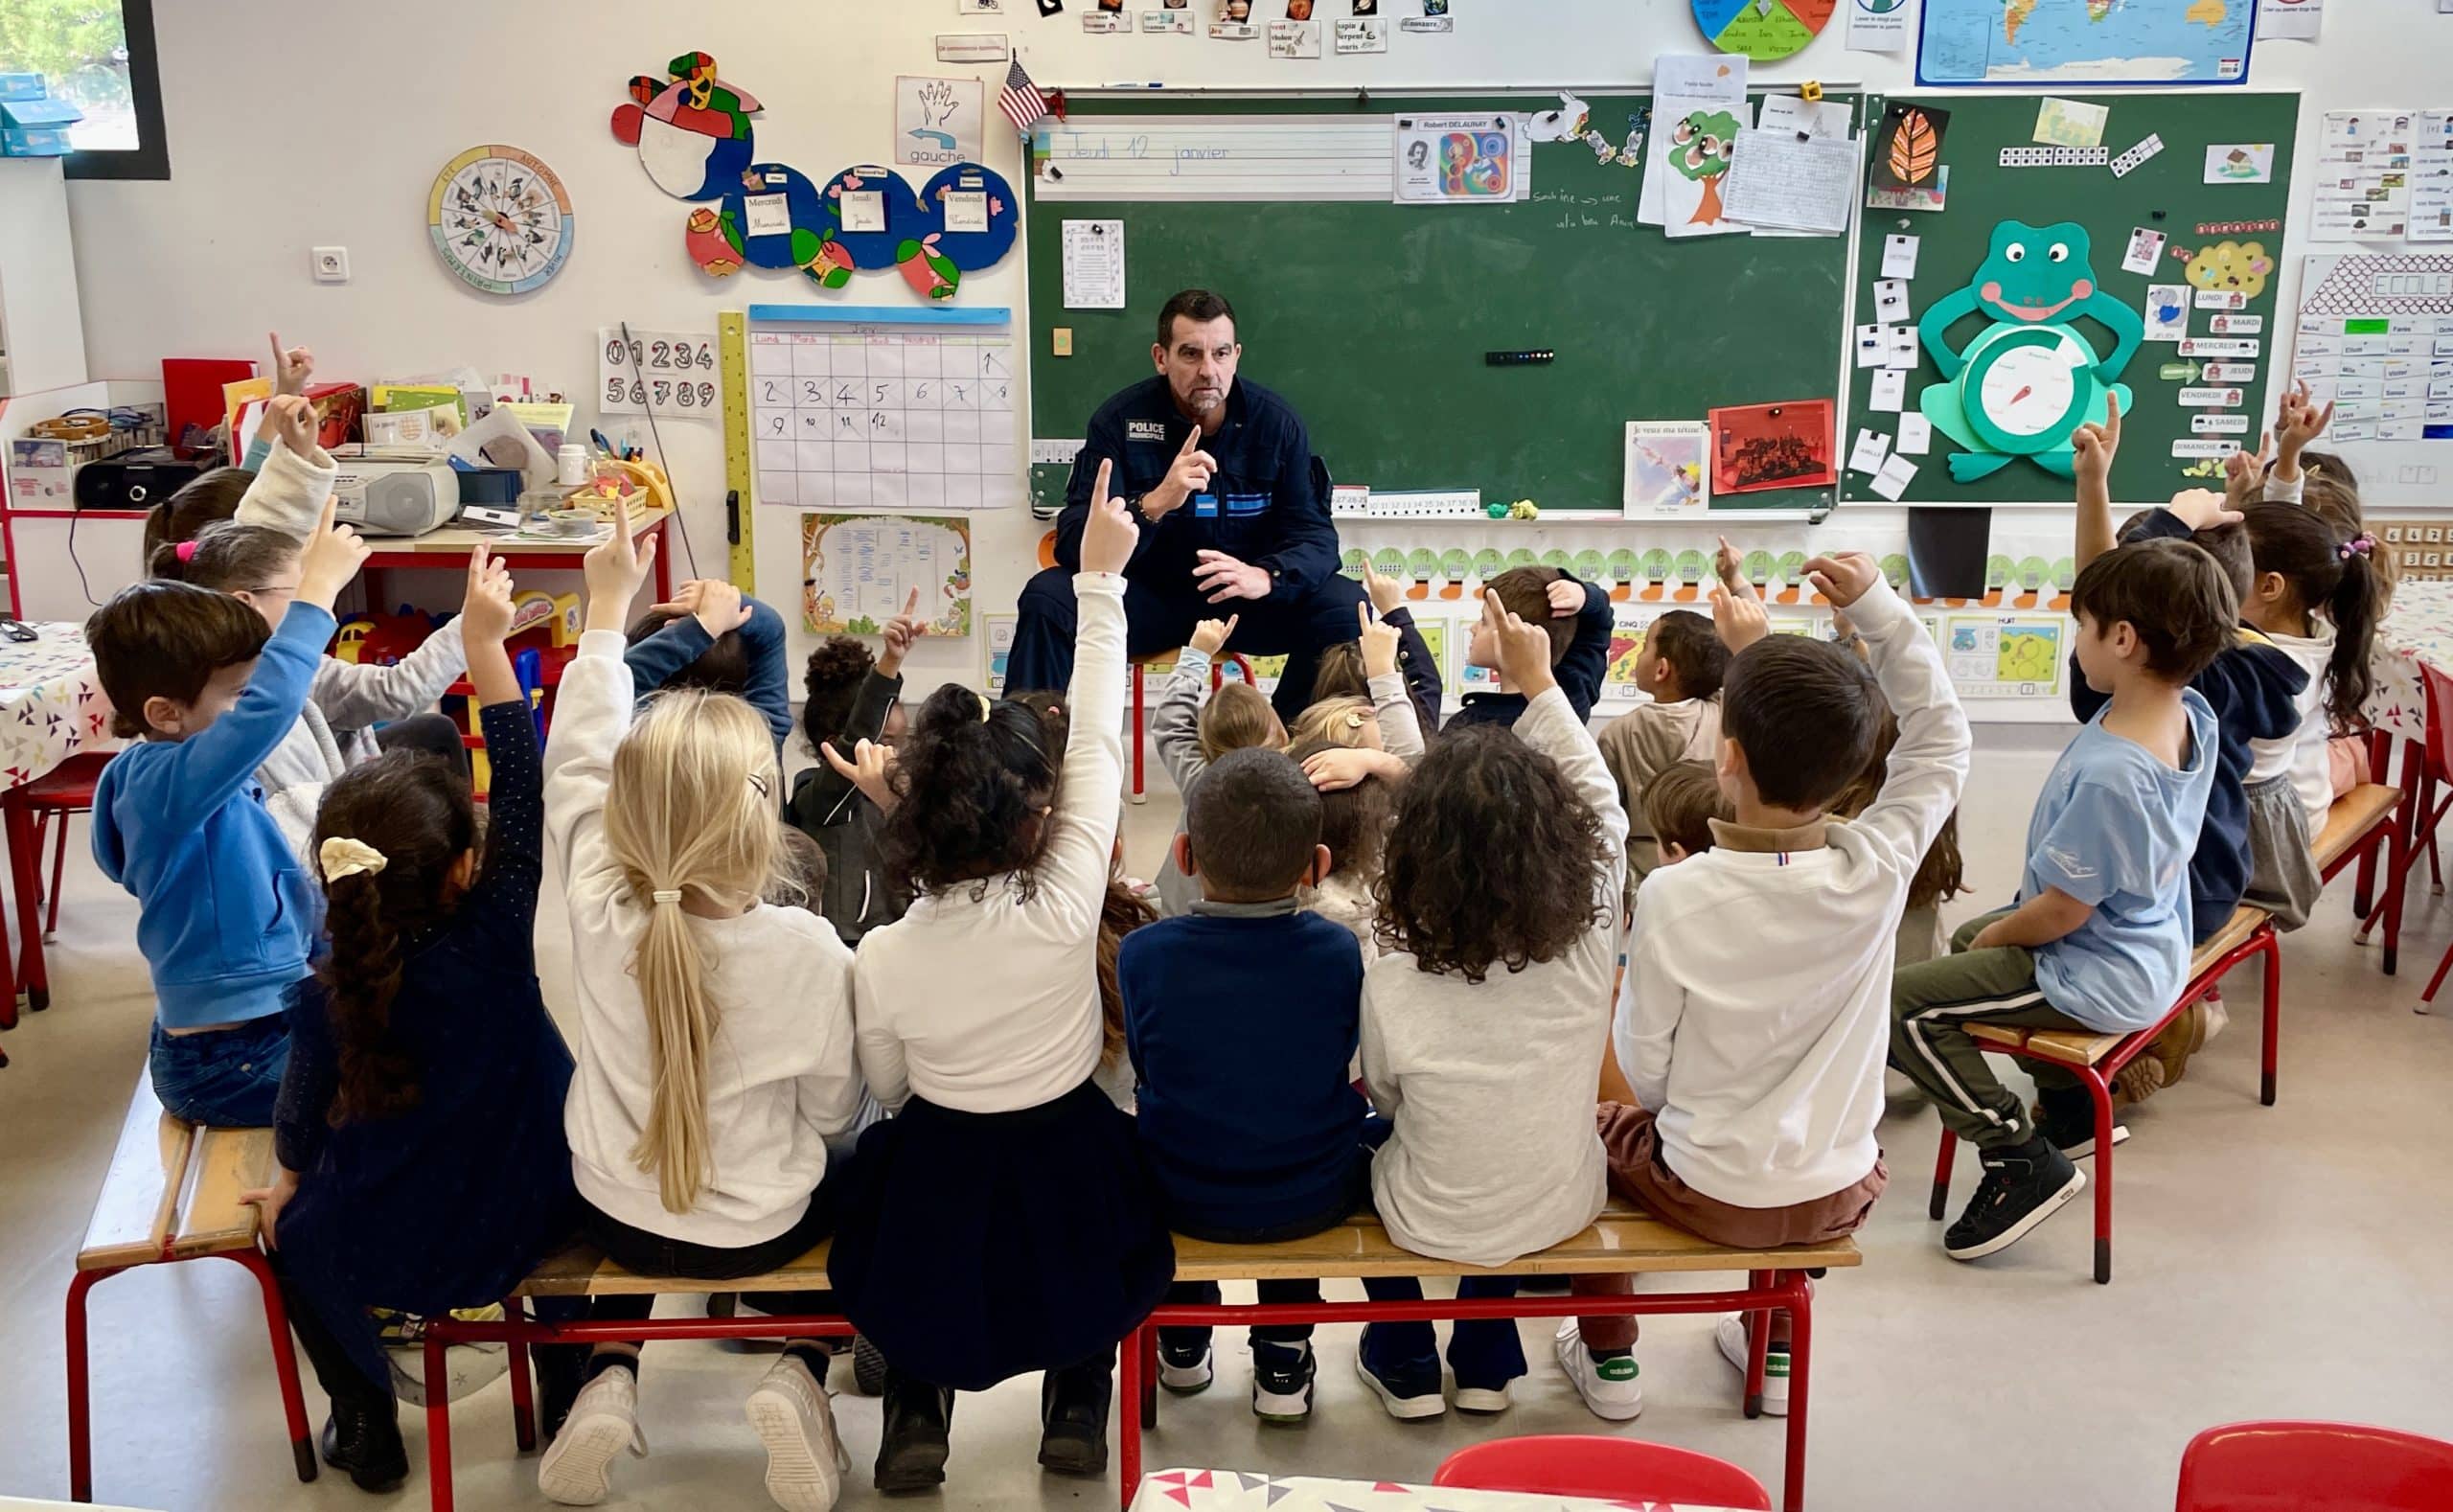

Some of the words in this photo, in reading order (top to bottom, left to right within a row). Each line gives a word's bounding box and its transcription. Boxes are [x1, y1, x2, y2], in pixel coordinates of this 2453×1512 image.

[1447, 120, 1488, 128] DELAUNAY
[910, 150, 966, 165] gauche
[1064, 132, 1111, 159] Jeudi
[1127, 135, 1150, 159] 12
[1169, 146, 1229, 176] janvier
[748, 196, 784, 208] Mercredi
[851, 194, 872, 202] Jeudi
[948, 195, 983, 204] Vendredi
[2197, 220, 2279, 233] SEMAINE
[2233, 318, 2260, 327] MARDI
[2195, 341, 2237, 350] MERCREDI
[607, 339, 625, 365] 0
[631, 339, 643, 366] 1
[652, 340, 671, 368] 2
[675, 342, 693, 369] 3
[695, 343, 713, 370] 4
[983, 352, 992, 375] 1
[607, 378, 625, 403] 5
[629, 380, 646, 404] 6
[653, 380, 671, 405] 7
[676, 382, 695, 407] 8
[698, 382, 715, 407] 9
[765, 381, 776, 402] 2
[804, 380, 821, 402] 3
[837, 383, 856, 406] 4
[876, 383, 889, 402] 5
[916, 382, 927, 400] 6
[954, 385, 965, 401] 7
[999, 385, 1007, 400] 8
[2181, 391, 2222, 400] VENDREDI
[773, 417, 785, 435] 9
[805, 417, 815, 426] 10
[841, 417, 851, 426] 11
[872, 412, 885, 430] 12
[2214, 418, 2247, 426] SAMEDI
[1129, 422, 1165, 433] POLICE
[2174, 443, 2218, 451] DIMANCHE
[2390, 531, 2397, 539] 6
[2411, 530, 2418, 539] 4
[2409, 554, 2416, 564] 3
[2428, 555, 2438, 563] 5
[1618, 620, 1638, 629] CINQ
